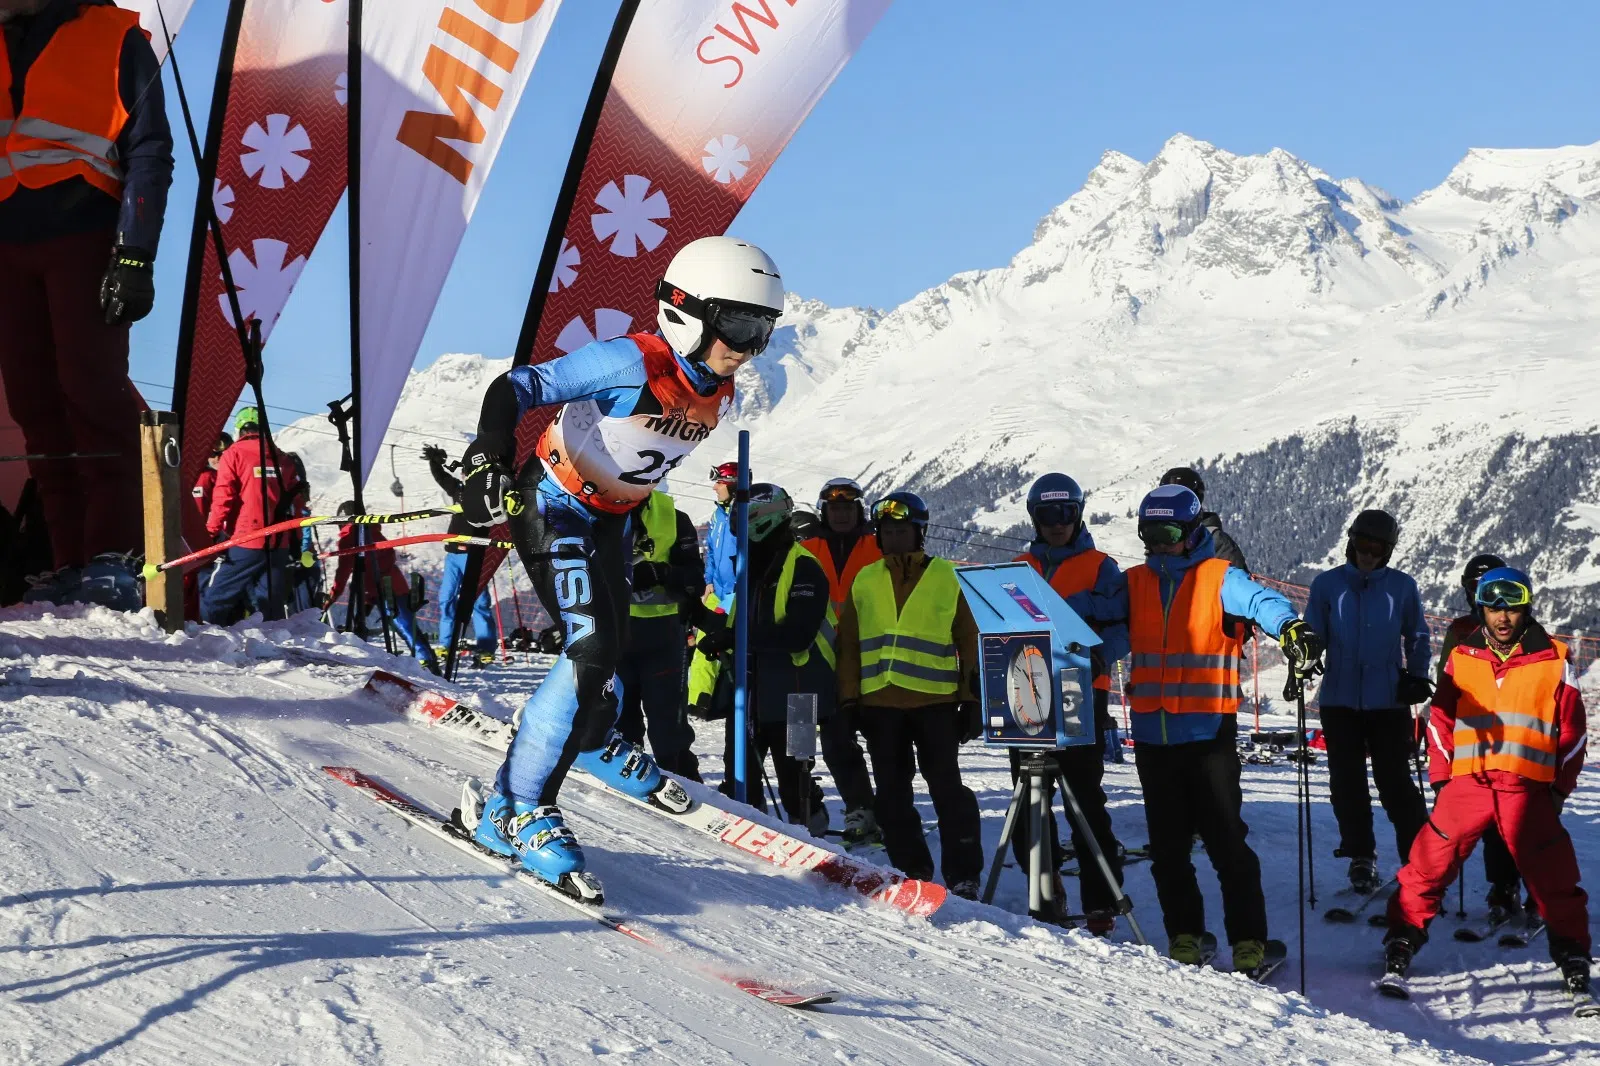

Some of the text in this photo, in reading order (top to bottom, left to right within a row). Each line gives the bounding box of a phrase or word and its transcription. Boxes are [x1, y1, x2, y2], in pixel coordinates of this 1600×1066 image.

[696, 0, 798, 89] SW
[119, 257, 144, 268] LEKI
[1041, 492, 1069, 500] RAIFFEISEN
[354, 514, 391, 524] LEKI
[550, 536, 596, 653] USA
